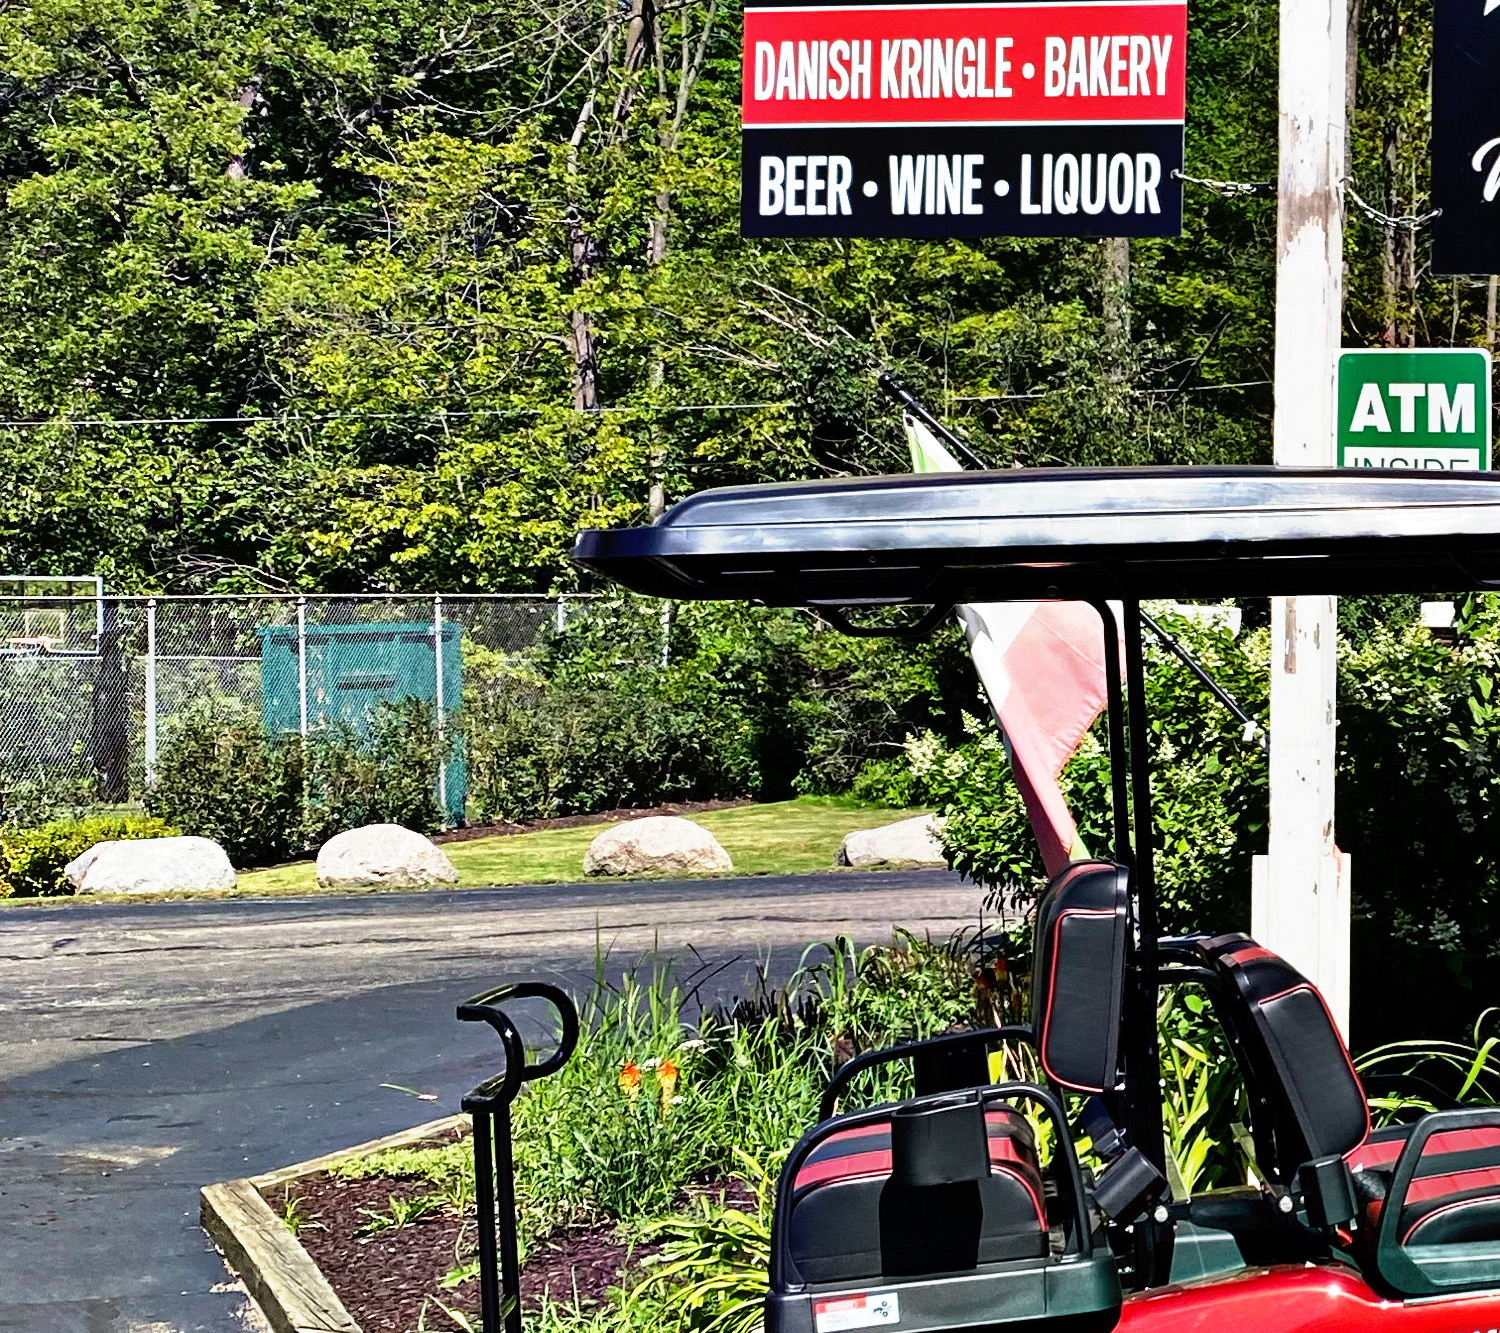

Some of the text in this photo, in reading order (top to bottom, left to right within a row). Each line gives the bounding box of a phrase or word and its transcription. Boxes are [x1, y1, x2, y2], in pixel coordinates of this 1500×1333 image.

[754, 34, 1173, 102] DANISH KRINGLE BAKERY
[759, 152, 1162, 217] BEER WINE LIQUOR
[1349, 382, 1475, 434] ATM
